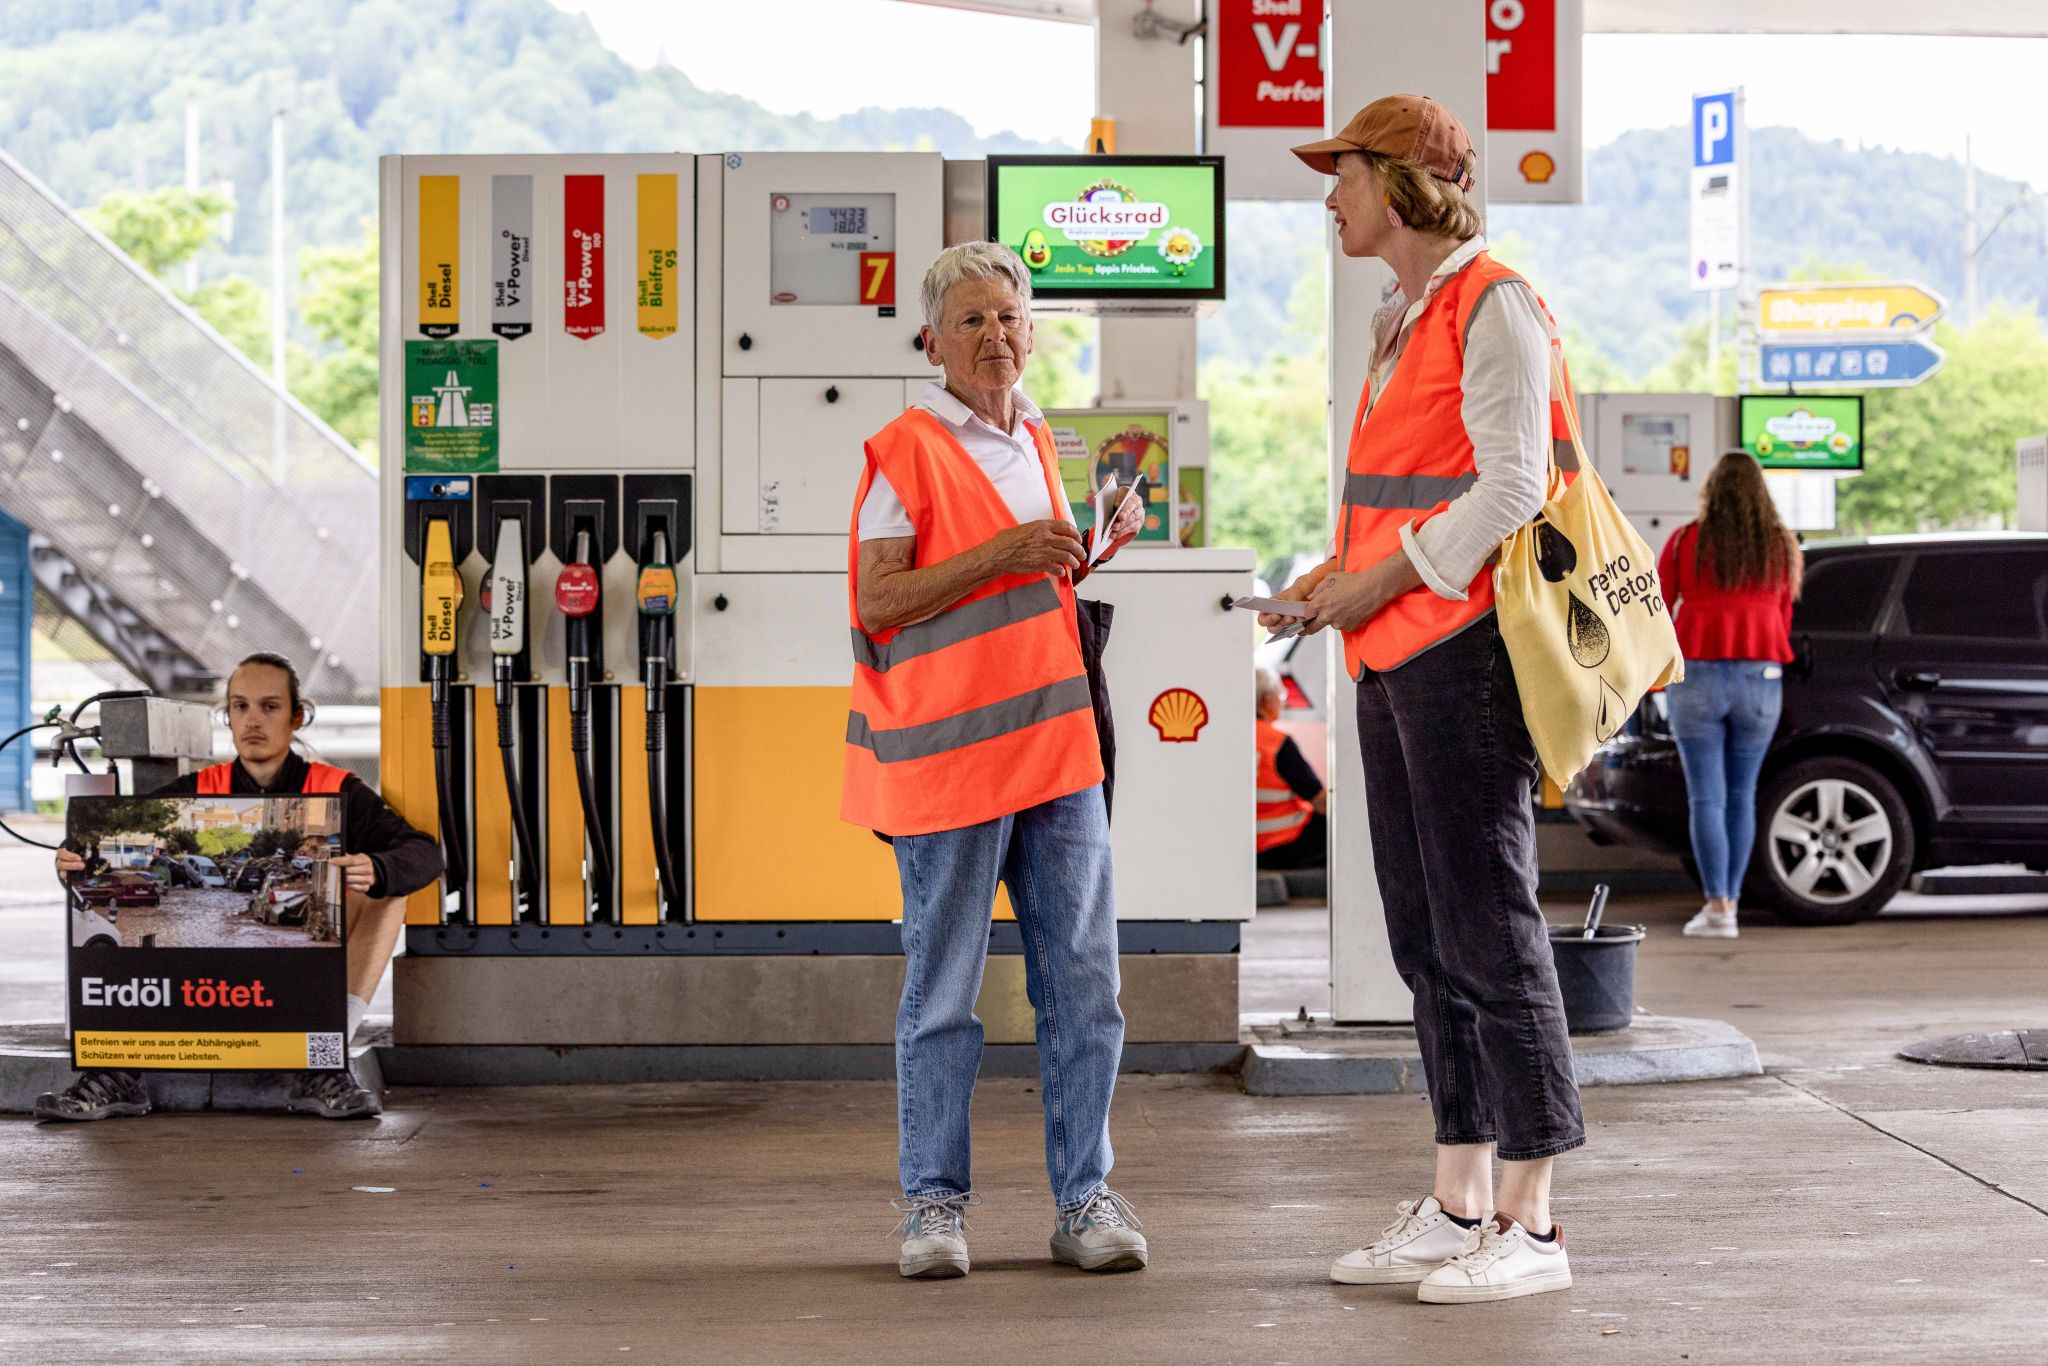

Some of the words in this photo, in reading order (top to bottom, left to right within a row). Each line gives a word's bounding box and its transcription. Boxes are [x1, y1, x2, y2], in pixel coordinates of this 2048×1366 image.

[1702, 101, 1728, 162] P
[1051, 206, 1162, 224] Glücksrad
[507, 233, 520, 308] V-Power
[578, 232, 592, 307] V-Power
[666, 249, 677, 268] 95
[439, 263, 451, 308] Diesel
[650, 248, 663, 308] Bleifrei
[865, 258, 890, 300] 7
[428, 282, 437, 308] Shell
[496, 282, 505, 308] Shell
[567, 281, 576, 308] Shell
[639, 280, 648, 307] Shell
[1769, 298, 1888, 328] Shopping
[428, 326, 450, 335] Diesel
[501, 326, 523, 335] Diesel
[1606, 569, 1656, 616] Detox
[440, 597, 452, 642] Diesel
[502, 579, 514, 640] V-Power
[428, 615, 437, 641] Shell
[81, 977, 171, 1007] Erdöl
[181, 978, 274, 1008] tötet.
[80, 1037, 119, 1047] Befreien
[122, 1037, 136, 1047] wir
[138, 1039, 156, 1047] uns
[158, 1039, 175, 1047] aus
[178, 1037, 194, 1048] der
[196, 1038, 262, 1050] Abhängigkeit.
[81, 1051, 125, 1061] Schützen
[127, 1051, 141, 1061] wir
[144, 1052, 176, 1061] unsere
[178, 1052, 222, 1061] Liebsten.
